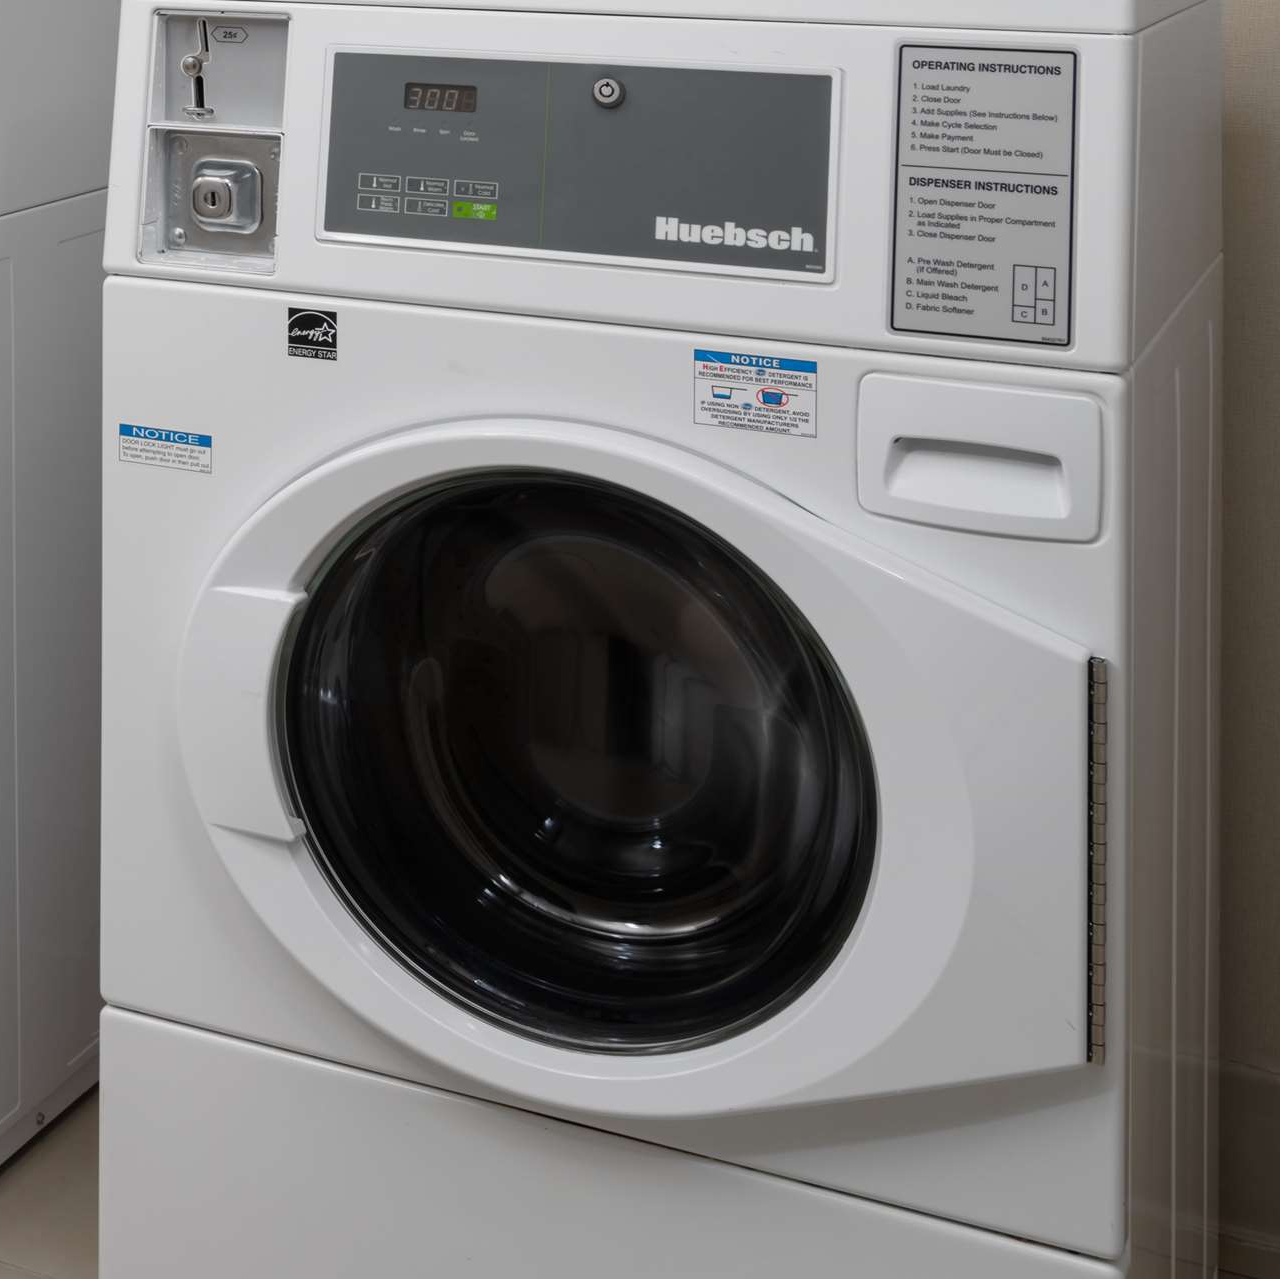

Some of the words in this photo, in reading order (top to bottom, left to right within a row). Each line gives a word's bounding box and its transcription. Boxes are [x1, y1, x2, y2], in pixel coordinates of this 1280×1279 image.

[912, 60, 975, 72] OPERATING
[978, 63, 1061, 75] INSTRUCTIONS
[922, 83, 939, 91] Load
[941, 84, 970, 93] Laundry
[921, 95, 942, 103] Close
[943, 96, 961, 104] Door
[937, 108, 967, 117] Supplies
[969, 110, 986, 119] (See
[988, 111, 1030, 120] Instructions
[1032, 113, 1058, 122] Below)
[942, 121, 962, 129] Cycle
[964, 122, 997, 130] Selection
[920, 132, 939, 140] Make
[941, 133, 973, 142] Payment
[919, 144, 940, 152] Press
[942, 145, 960, 153] Start
[961, 146, 982, 155] (Door
[983, 148, 1001, 156] Must
[1003, 149, 1012, 157] be
[1014, 150, 1043, 159] Closed)
[909, 177, 971, 190] DISPENSER
[974, 181, 1058, 195] INSTRUCTIONS
[917, 197, 937, 206] Open
[939, 199, 976, 209] Dispenser
[978, 201, 996, 209] Door
[917, 211, 935, 219] Load
[937, 212, 968, 222] Supplies
[978, 215, 1003, 224] Proper
[1005, 217, 1056, 228] Compartment
[928, 221, 960, 229] Indicated
[655, 216, 814, 252] Huebsch
[917, 230, 937, 238] Close
[939, 231, 976, 241] Dispenser
[977, 234, 996, 242] Door
[917, 257, 931, 265] Pre
[932, 258, 954, 267] Wash
[956, 260, 994, 271] Detergent
[926, 267, 958, 277] Offered)
[906, 277, 914, 285] B.
[916, 278, 935, 286] Main
[937, 280, 959, 289] Wash
[960, 282, 999, 292] Detergent
[1021, 283, 1028, 291] D
[1041, 280, 1049, 288] A
[906, 290, 914, 298] C.
[917, 291, 939, 300] Liquid
[941, 293, 968, 302] Bleach
[906, 302, 913, 310] D.
[916, 303, 940, 312] Fabric
[942, 305, 974, 315] Softener
[1020, 310, 1028, 318] C
[1041, 308, 1048, 316] B
[289, 347, 316, 356] ENERGY
[317, 351, 337, 359] STAR
[731, 355, 780, 367] NOTICE
[699, 371, 741, 380] RECOMMENDED
[770, 379, 813, 389] PERFORMANCE
[768, 372, 802, 380] DETERGENT
[701, 406, 741, 416] OVERSUDSING
[711, 413, 745, 422] DETERGENT
[747, 417, 799, 428] MANUFACTURERS
[718, 420, 764, 431] RECOMMENDED
[133, 427, 200, 445] NOTICE
[140, 448, 166, 456] attempting
